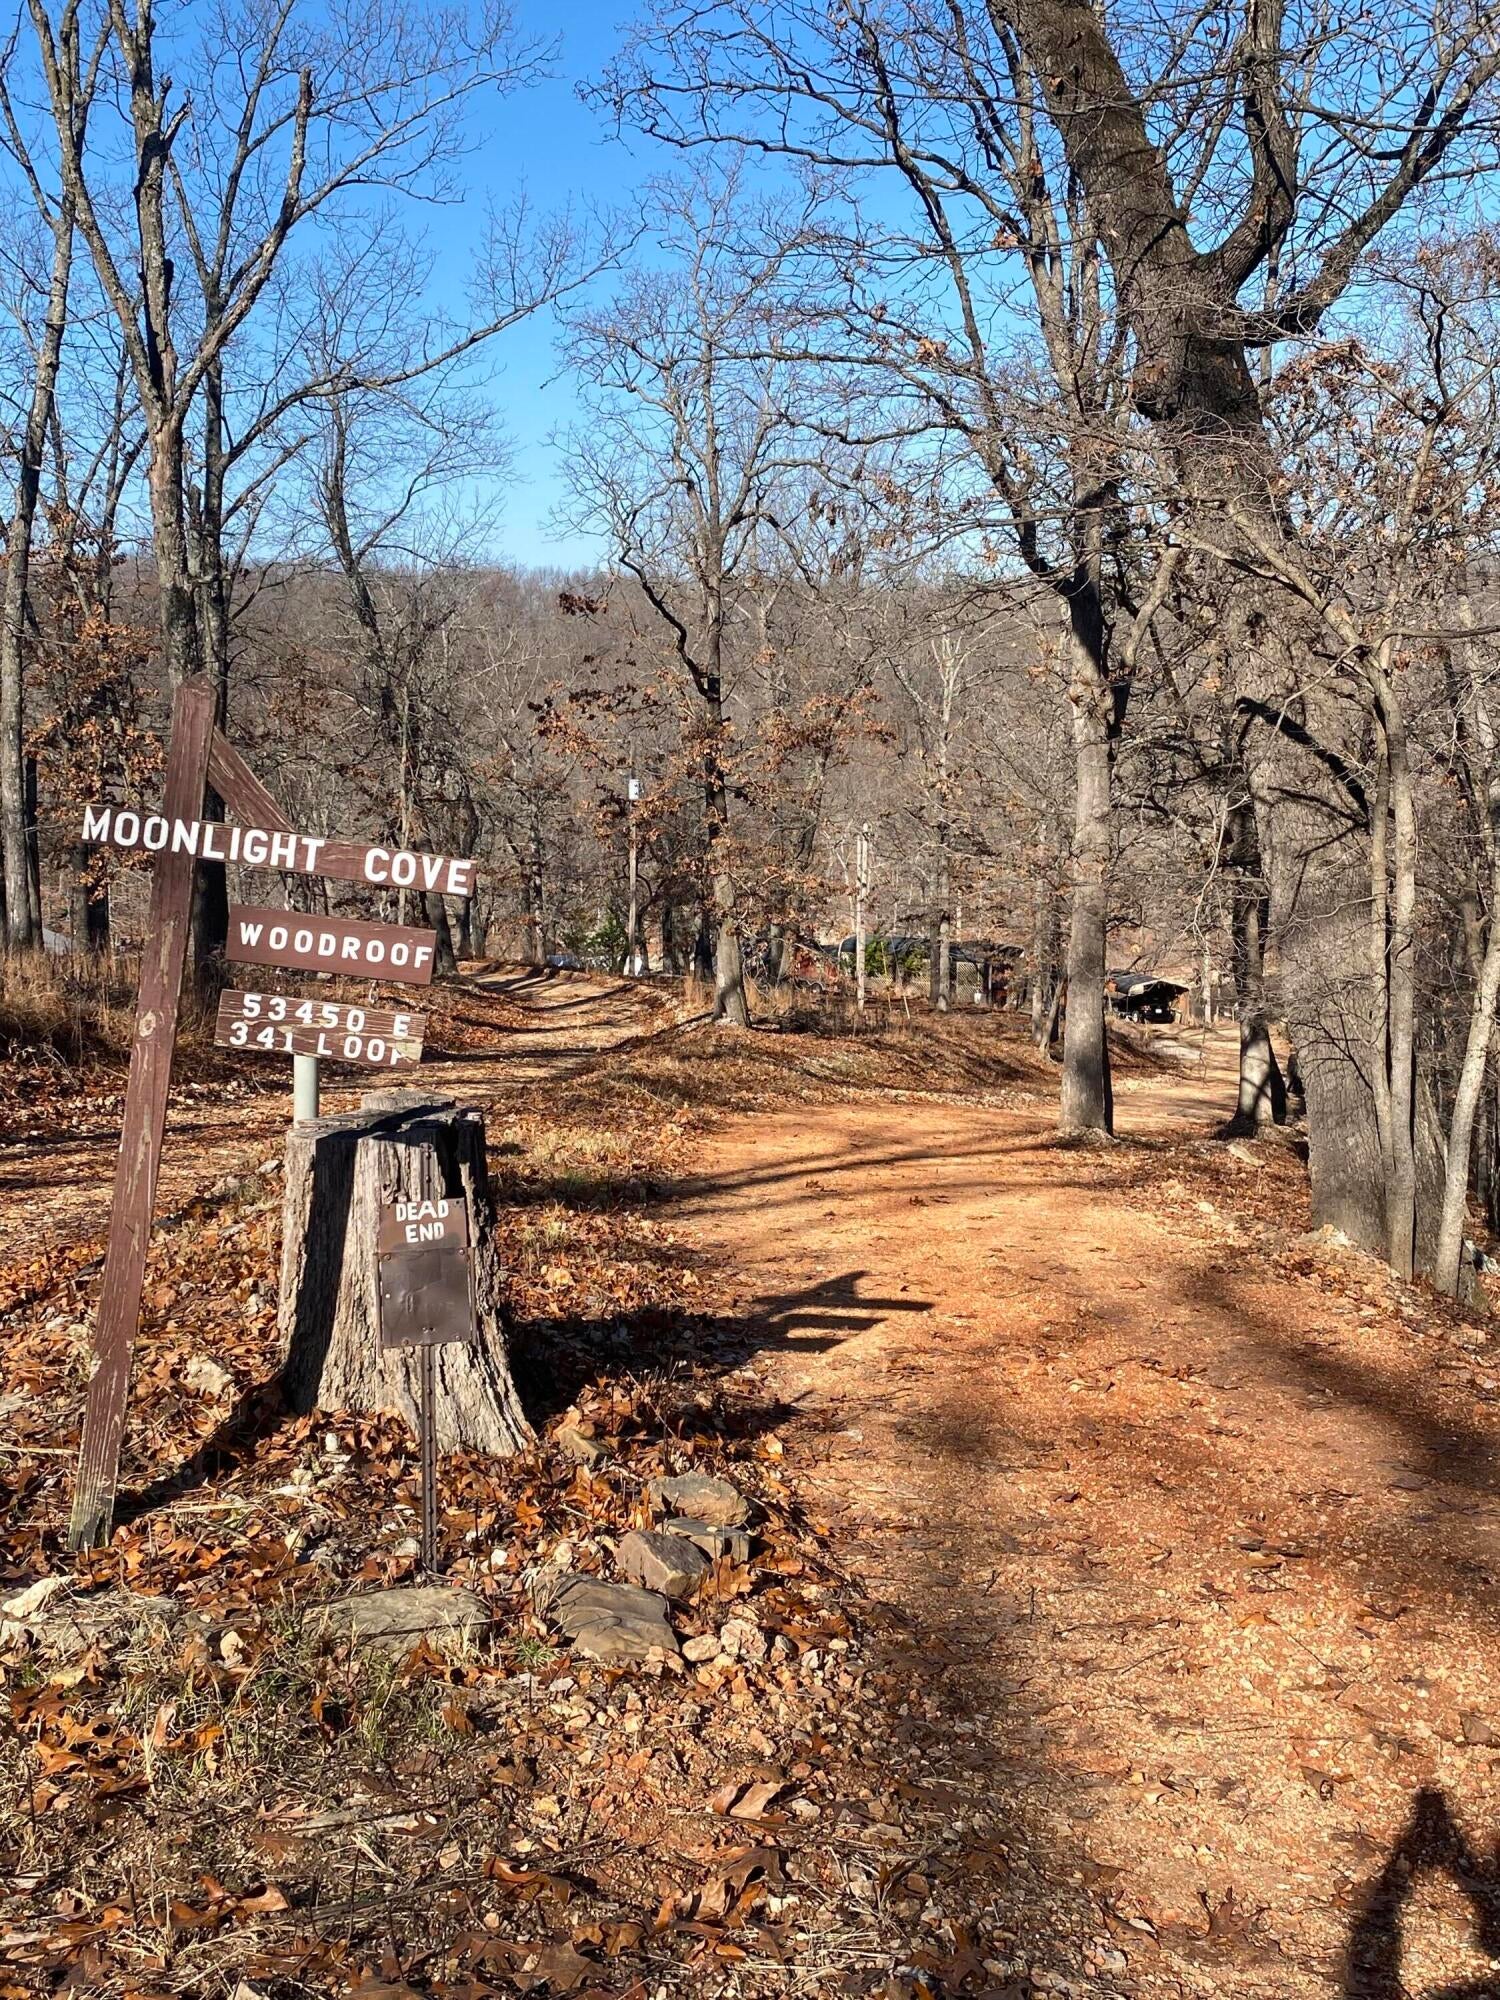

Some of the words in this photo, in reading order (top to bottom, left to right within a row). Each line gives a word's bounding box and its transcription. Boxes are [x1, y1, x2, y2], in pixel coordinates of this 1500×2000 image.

[81, 807, 325, 872] MOONLIGHT
[364, 847, 474, 895] COVE
[240, 921, 433, 969] WOODROOF
[242, 993, 365, 1033] 53450
[393, 1014, 411, 1038] E
[229, 1021, 293, 1053] 341
[396, 1199, 449, 1222] DEAD
[405, 1222, 445, 1243] END
